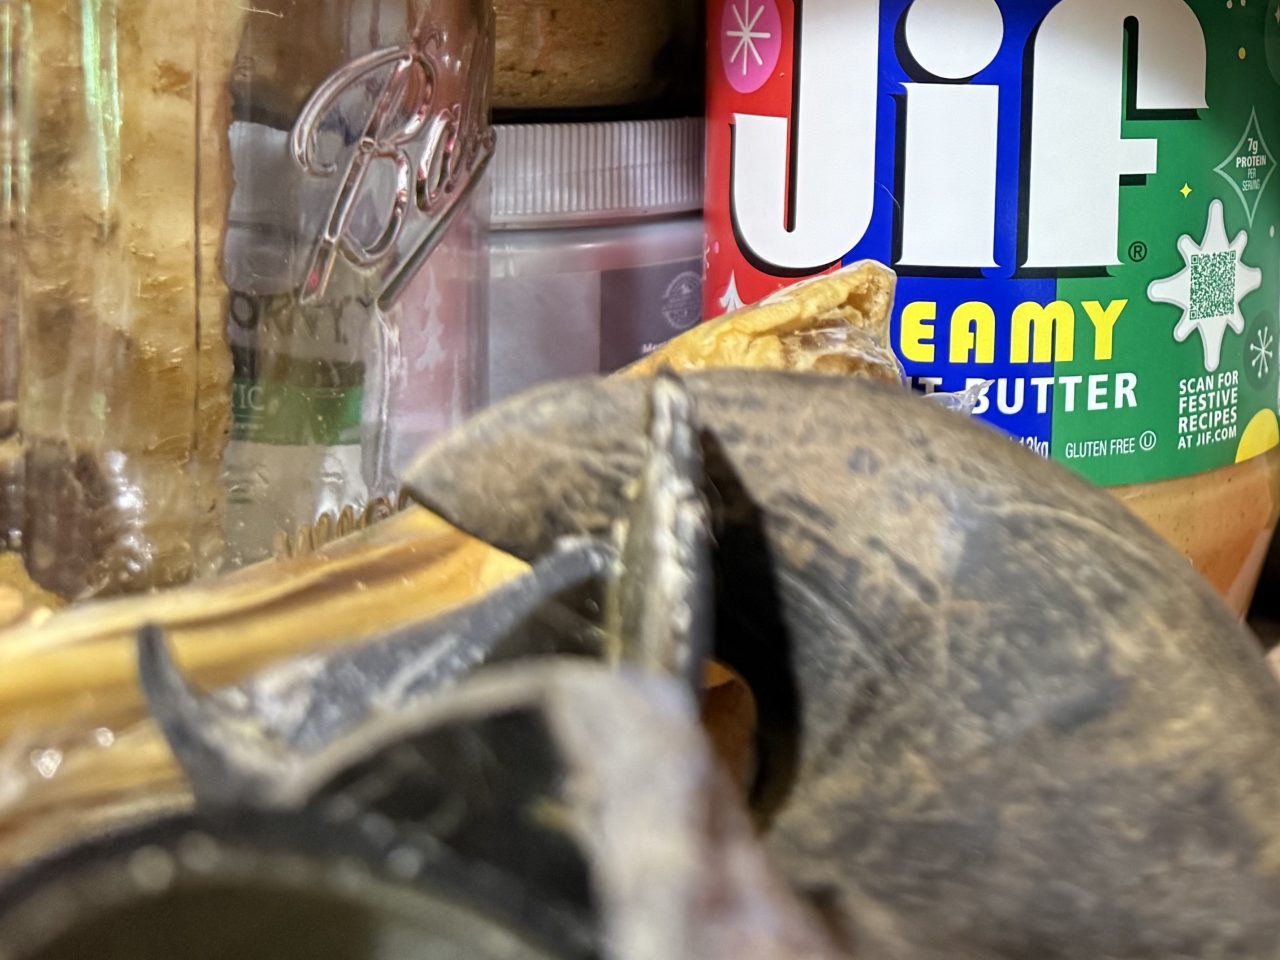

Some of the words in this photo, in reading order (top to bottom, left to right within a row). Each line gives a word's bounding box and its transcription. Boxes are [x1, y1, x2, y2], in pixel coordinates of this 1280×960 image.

[1247, 137, 1259, 155] 7g
[1235, 155, 1267, 168] PROTEIN
[1247, 168, 1257, 179] PER
[1241, 179, 1261, 192] SERVING
[965, 371, 1139, 416] BUTTER
[1179, 375, 1214, 395] SCAN
[1218, 370, 1239, 389] FOR
[1179, 387, 1239, 415] FESTIVE
[1178, 406, 1238, 434] RECIPES
[1065, 439, 1108, 459] GLUTEN
[1110, 437, 1136, 455] FREE
[1177, 434, 1193, 450] AT
[1196, 424, 1237, 447] JIF.COM
